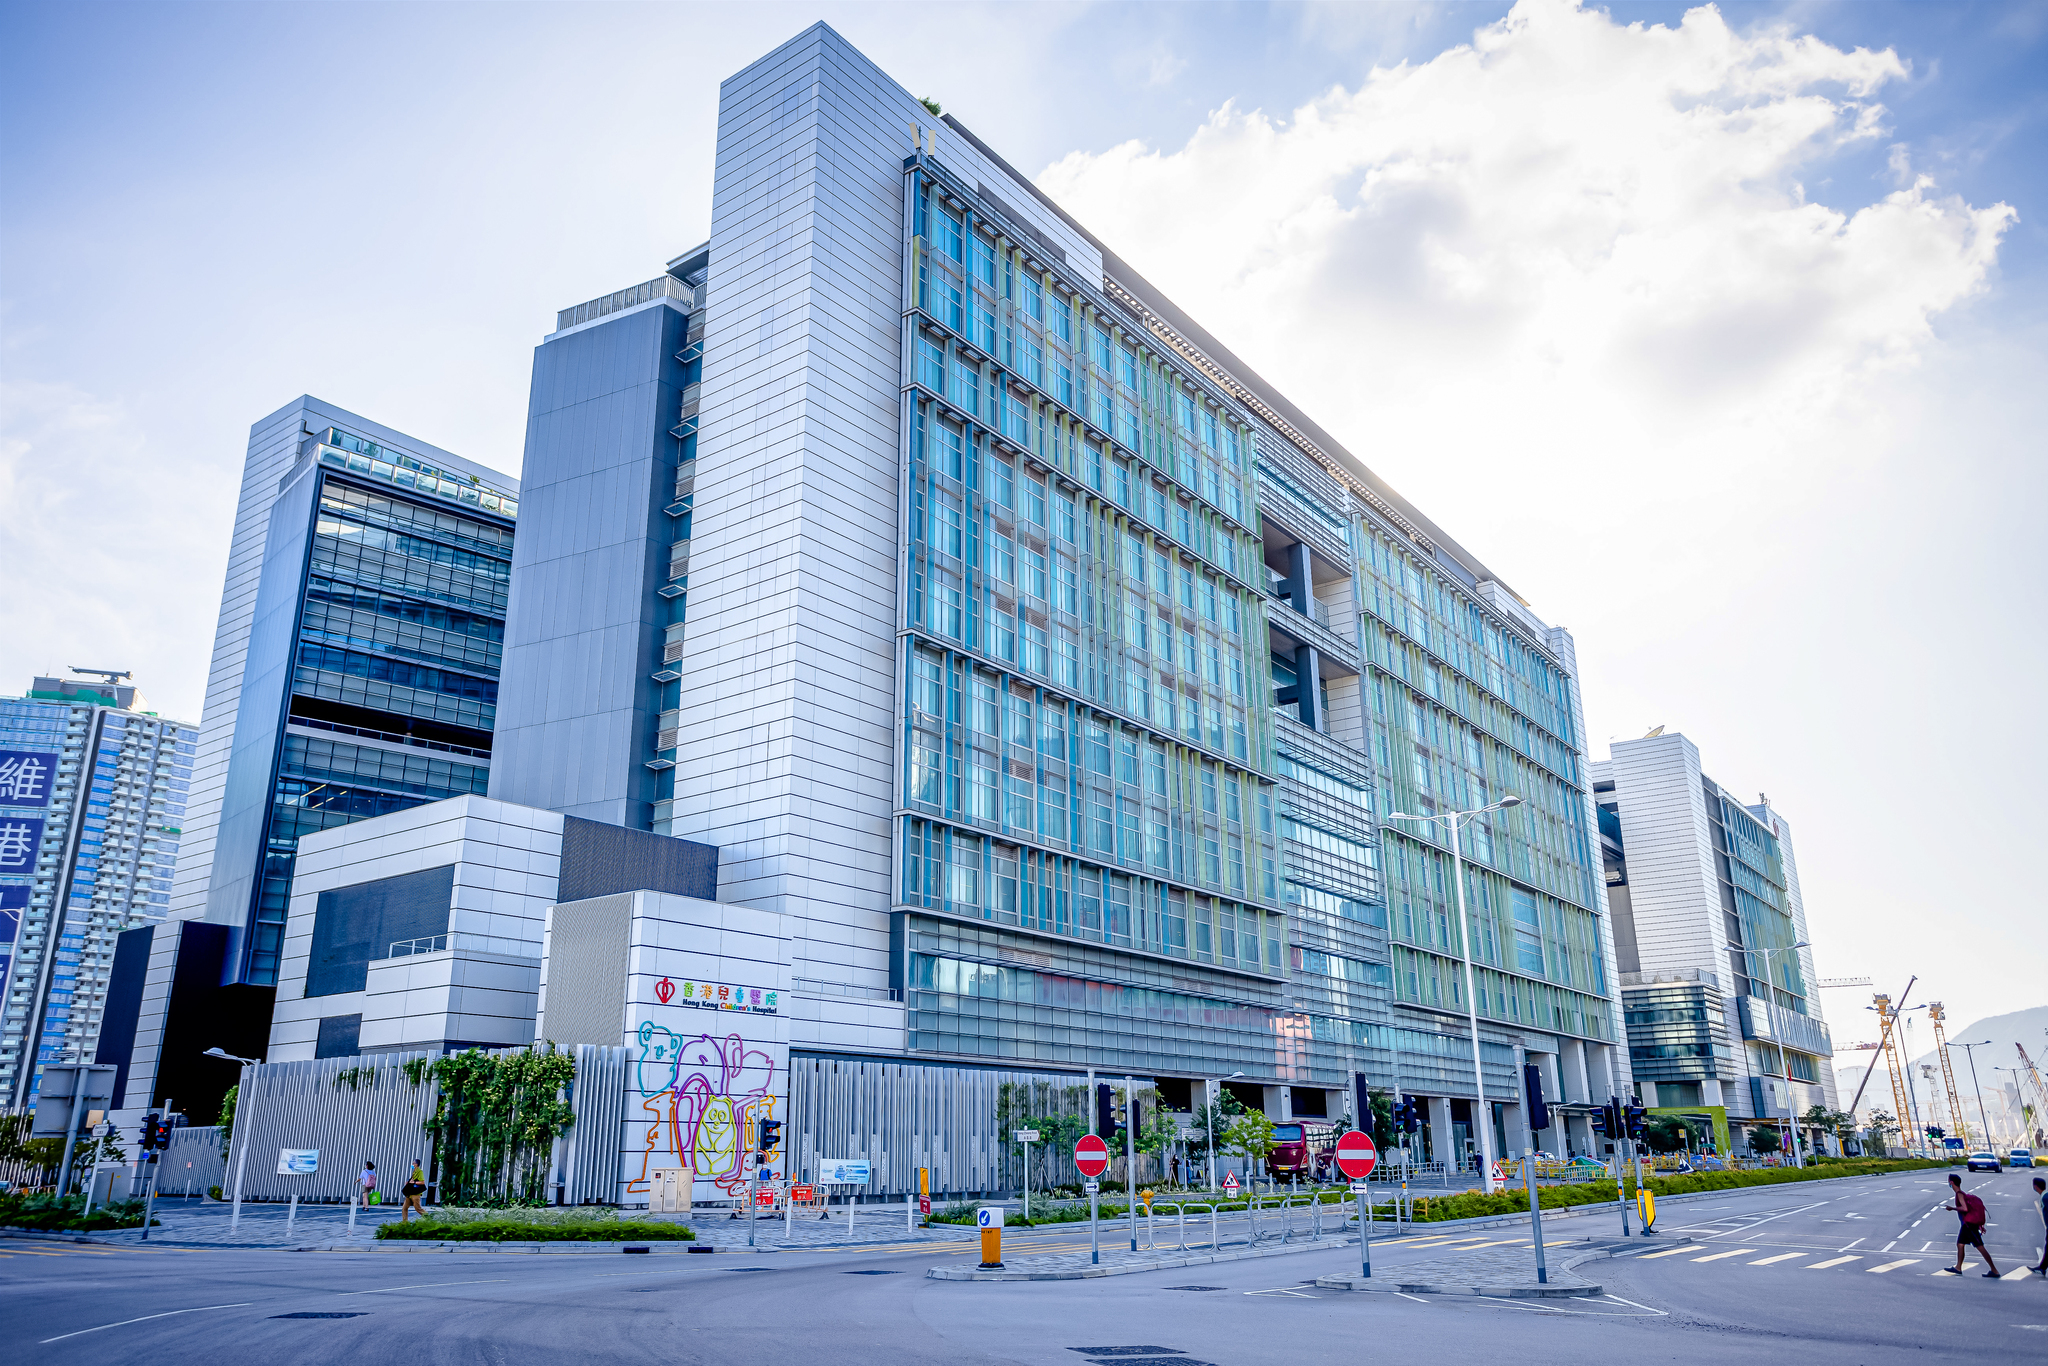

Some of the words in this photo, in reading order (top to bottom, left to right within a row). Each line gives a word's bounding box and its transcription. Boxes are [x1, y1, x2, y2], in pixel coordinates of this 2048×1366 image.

[684, 982, 777, 1005] 香港兒童醫院
[682, 999, 700, 1008] Hong
[702, 1001, 719, 1009] Kong
[720, 1002, 751, 1011] Children's
[752, 1006, 777, 1014] Hospital
